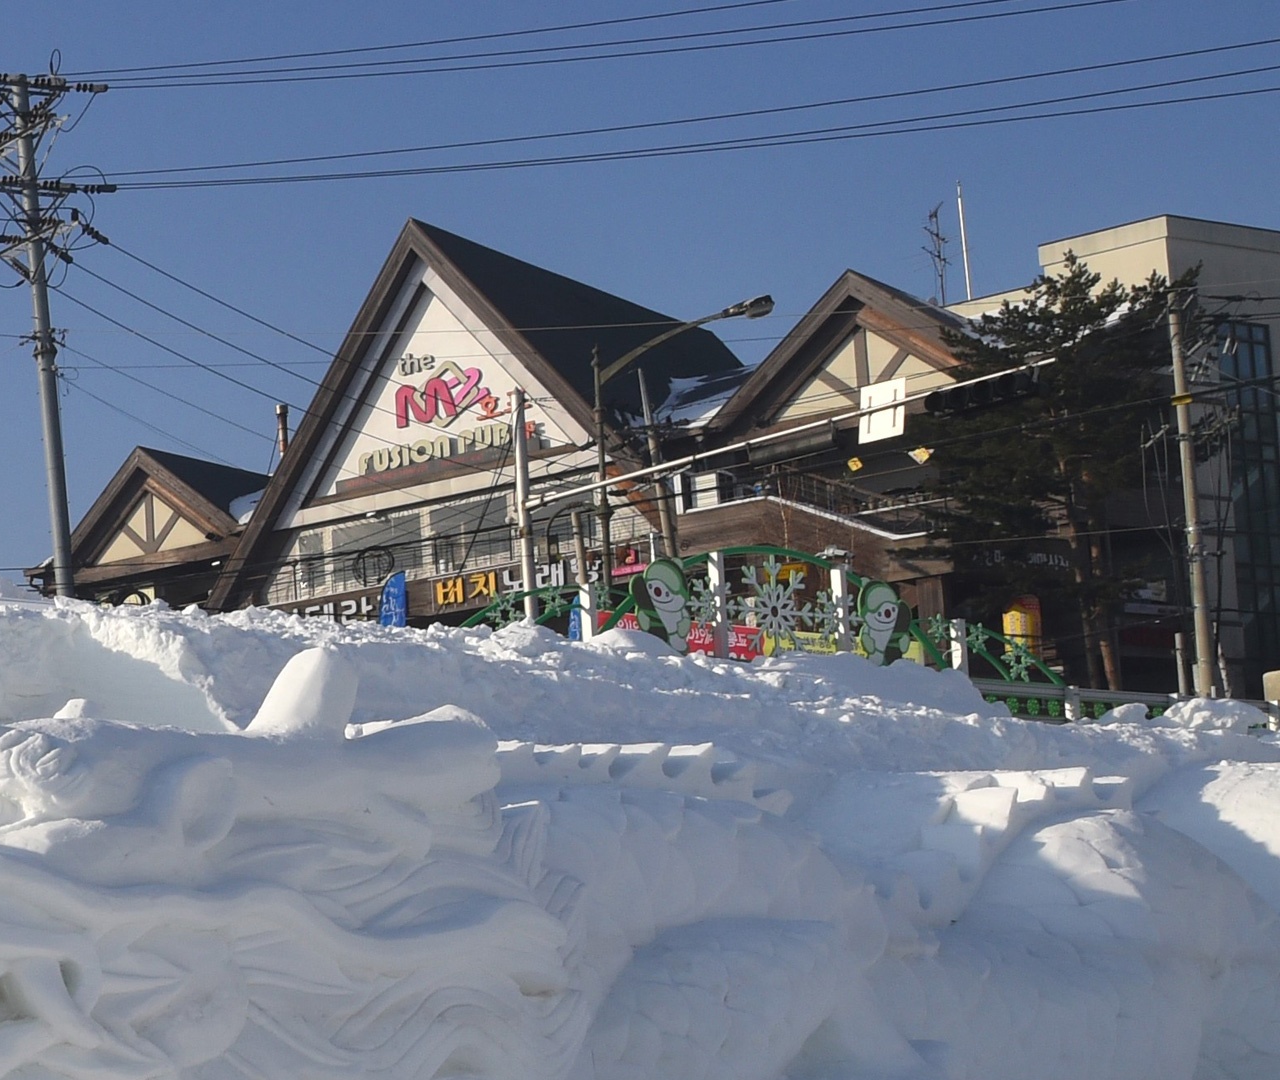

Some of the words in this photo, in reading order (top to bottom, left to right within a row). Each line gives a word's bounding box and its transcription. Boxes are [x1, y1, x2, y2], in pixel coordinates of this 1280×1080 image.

[398, 353, 434, 376] the
[358, 437, 451, 476] FUSION
[458, 423, 511, 454] PUB
